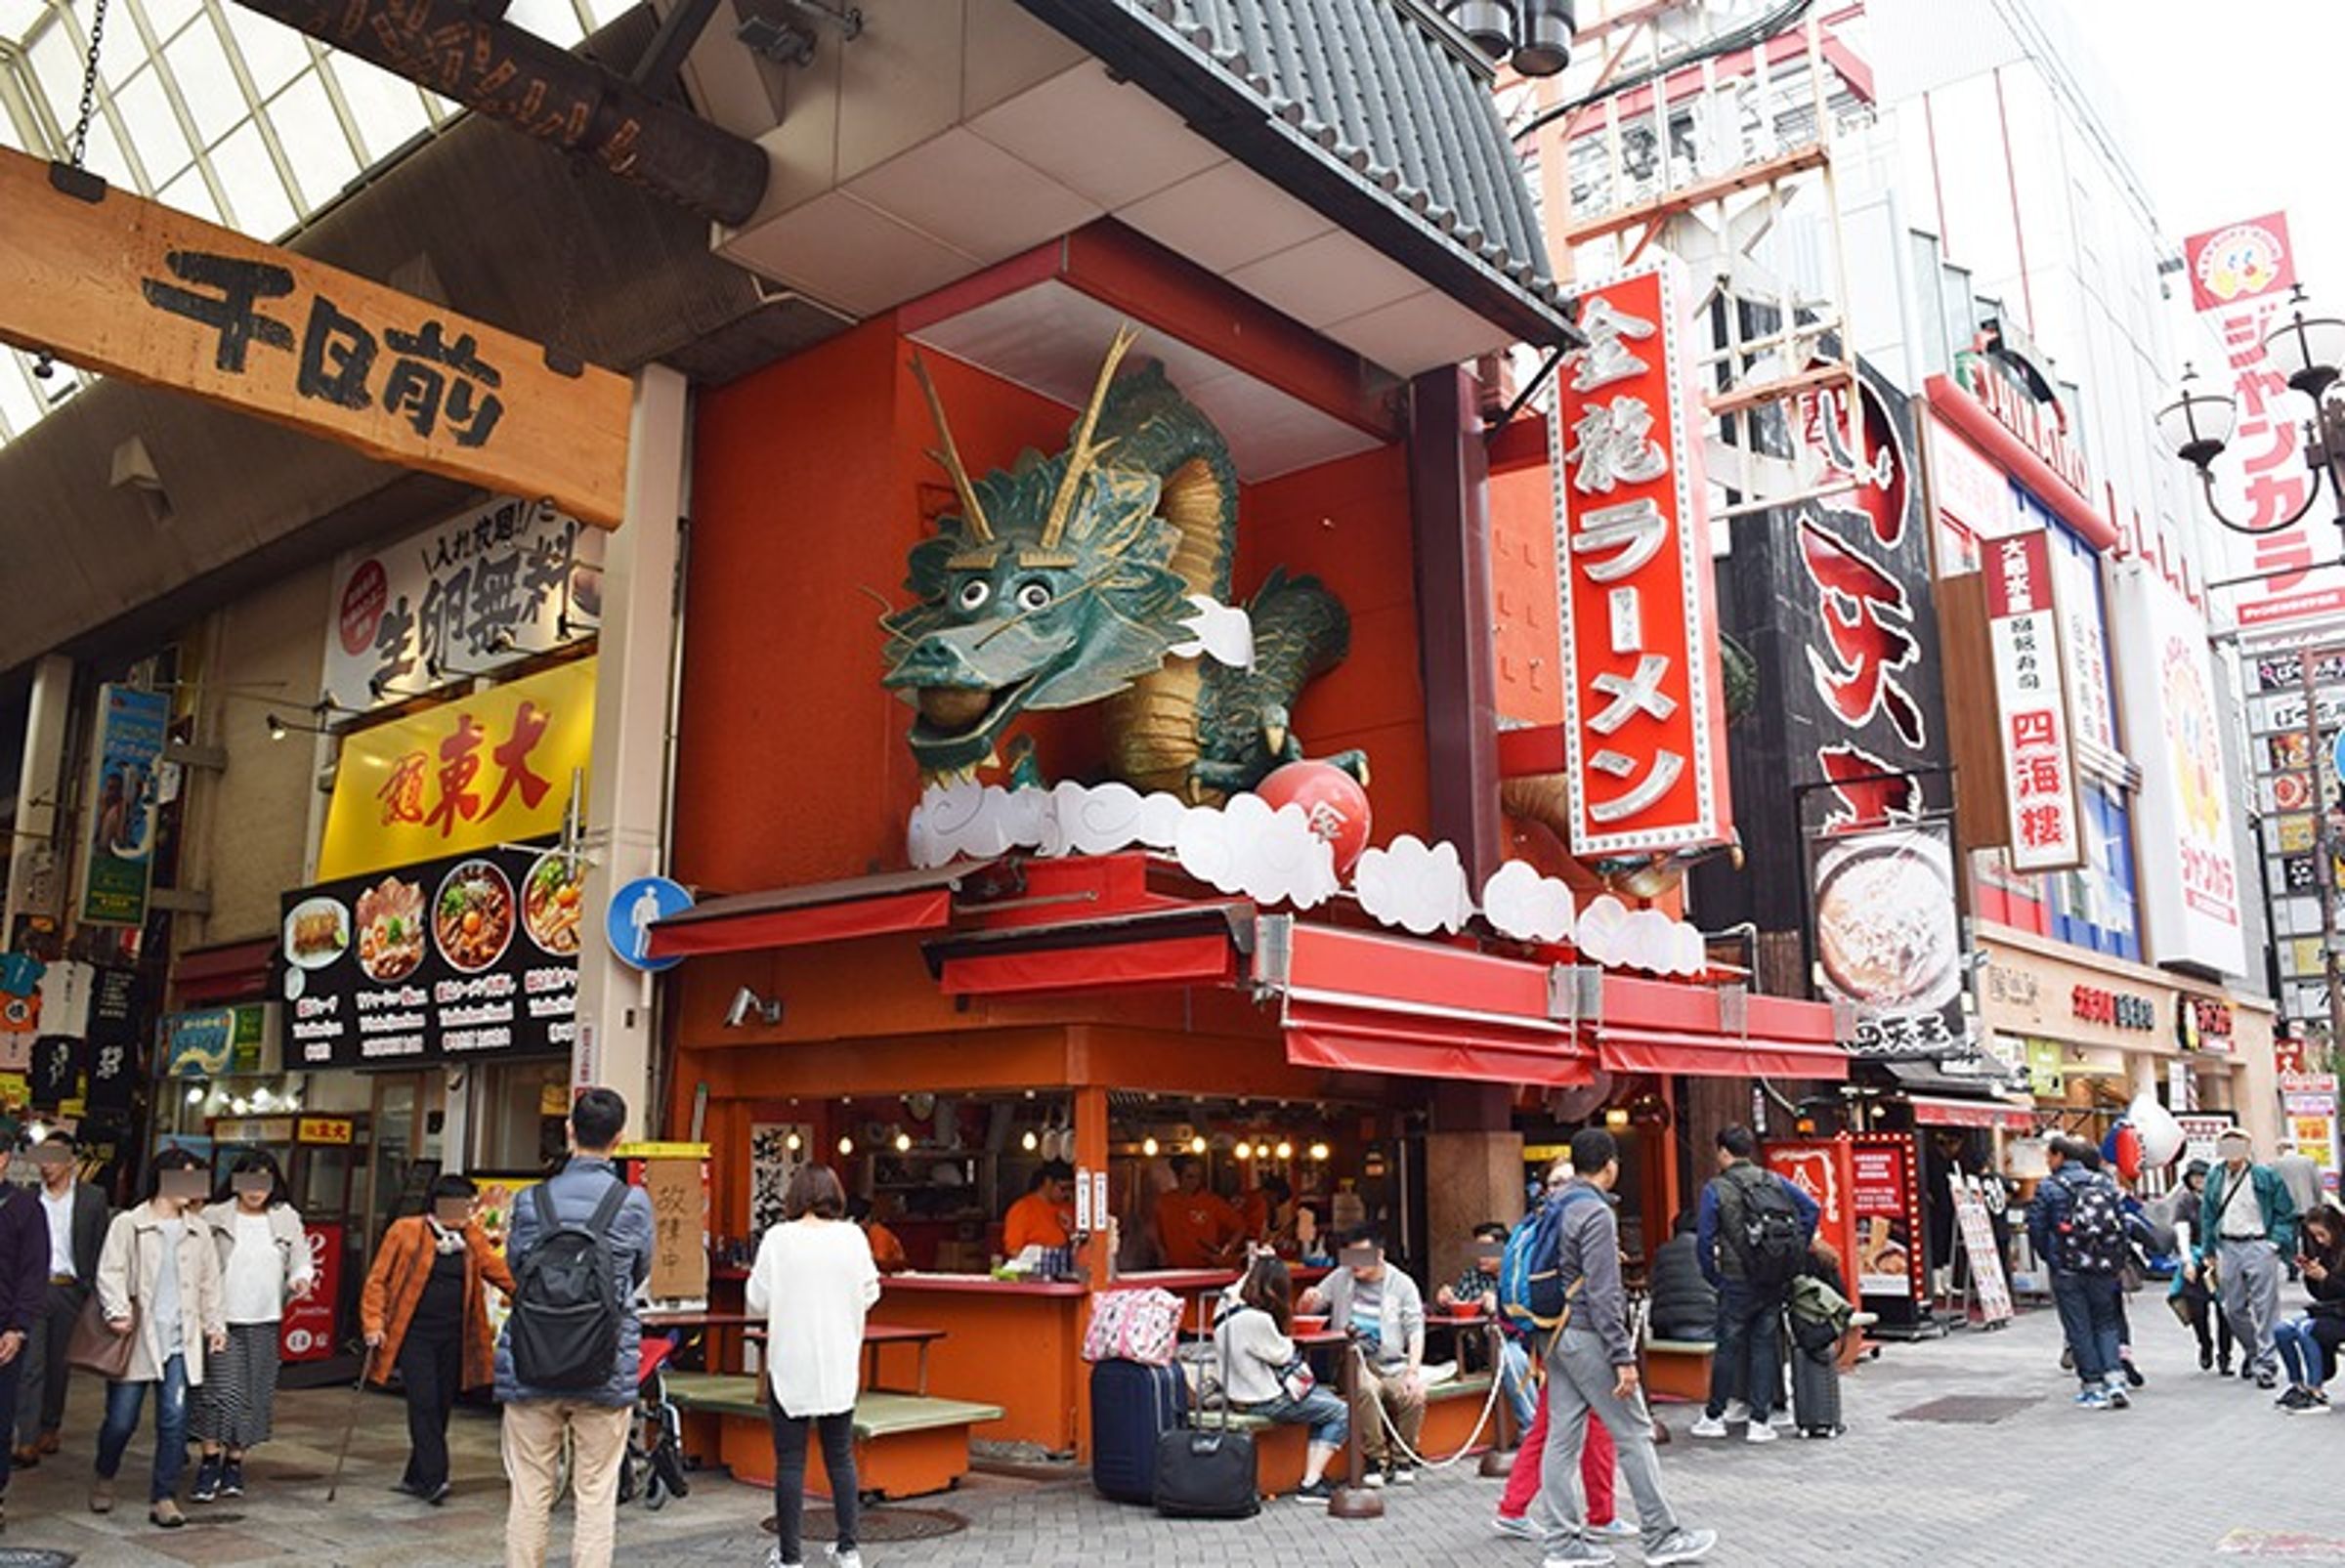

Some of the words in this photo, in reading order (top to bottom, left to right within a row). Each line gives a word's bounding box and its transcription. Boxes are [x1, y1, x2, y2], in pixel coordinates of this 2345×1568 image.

[142, 250, 506, 448] 千日前
[2225, 301, 2315, 594] ジャンカラ
[374, 522, 576, 682] 生卵無料
[1564, 296, 1686, 824] 金龍ラーメン
